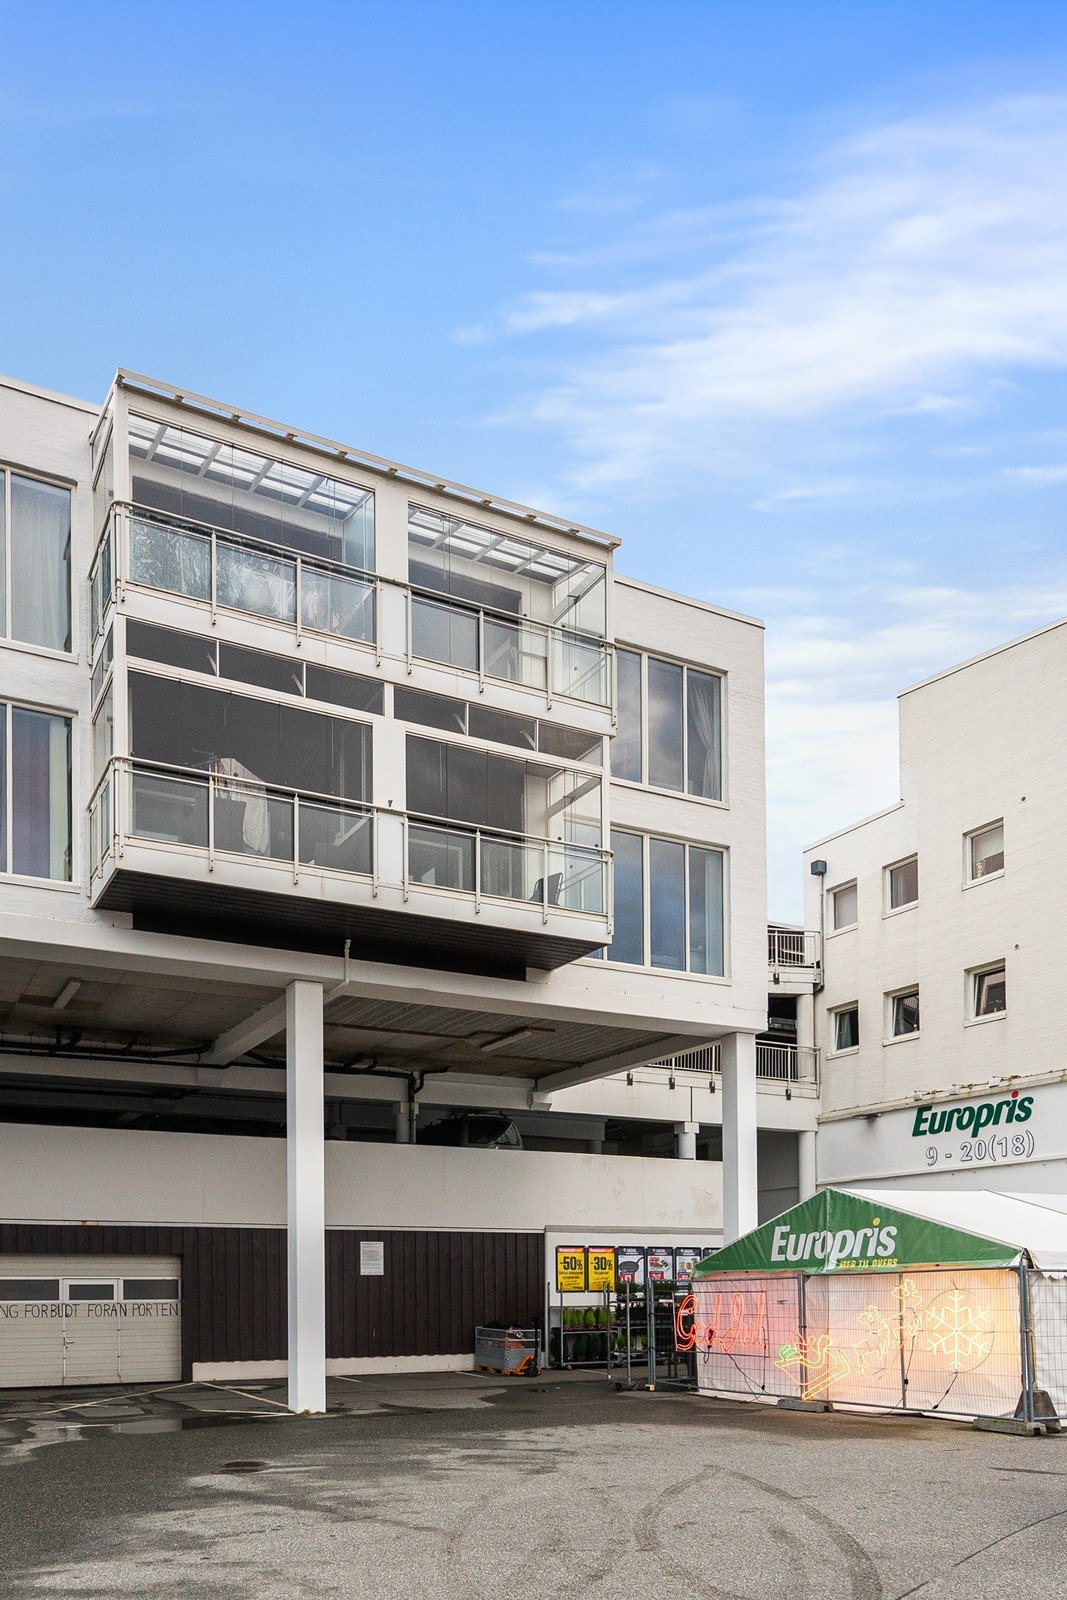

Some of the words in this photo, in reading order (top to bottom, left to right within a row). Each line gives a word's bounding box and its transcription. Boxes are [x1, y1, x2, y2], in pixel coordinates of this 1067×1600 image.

[912, 1091, 1034, 1138] Europris
[926, 1146, 938, 1166] 9
[960, 1130, 1035, 1161] 20(18)
[771, 1217, 898, 1270] Europris
[560, 1256, 583, 1271] -50%
[590, 1256, 613, 1271] -30%
[871, 1258, 898, 1268] OVERS
[24, 1304, 80, 1318] FORBUDT
[87, 1303, 127, 1317] FORAN
[132, 1302, 179, 1317] PORTEN
[676, 1293, 722, 1351] God
[721, 1292, 765, 1354] Jul
